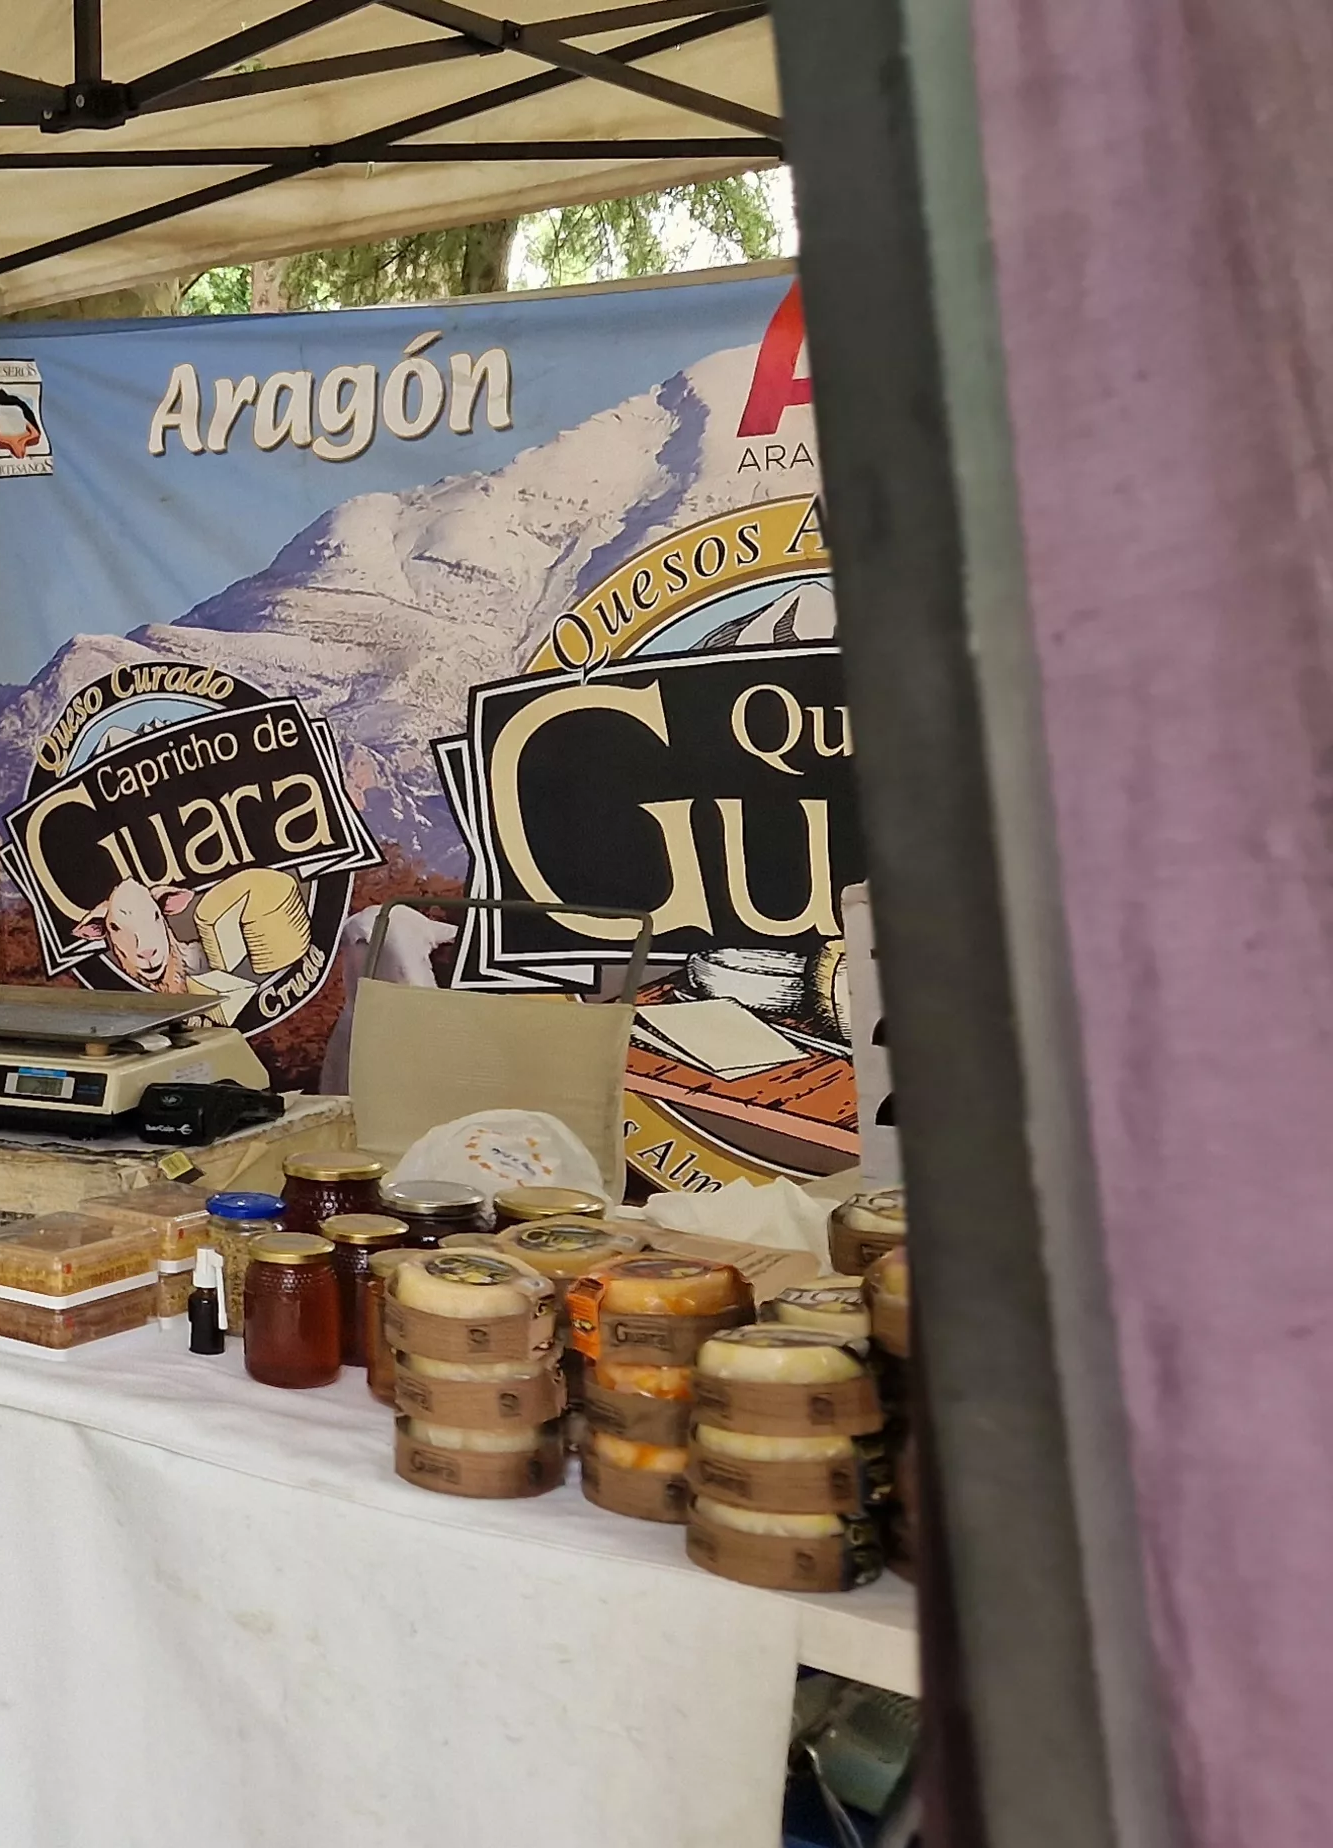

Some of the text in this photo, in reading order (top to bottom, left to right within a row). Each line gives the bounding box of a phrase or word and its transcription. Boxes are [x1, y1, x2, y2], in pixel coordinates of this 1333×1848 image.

[148, 330, 513, 461] Aragón
[550, 515, 762, 684] Quesos
[35, 661, 235, 773] Queso Curado
[96, 713, 300, 803] Capricho de
[25, 772, 336, 923] Guara
[258, 946, 327, 1020] Cruda
